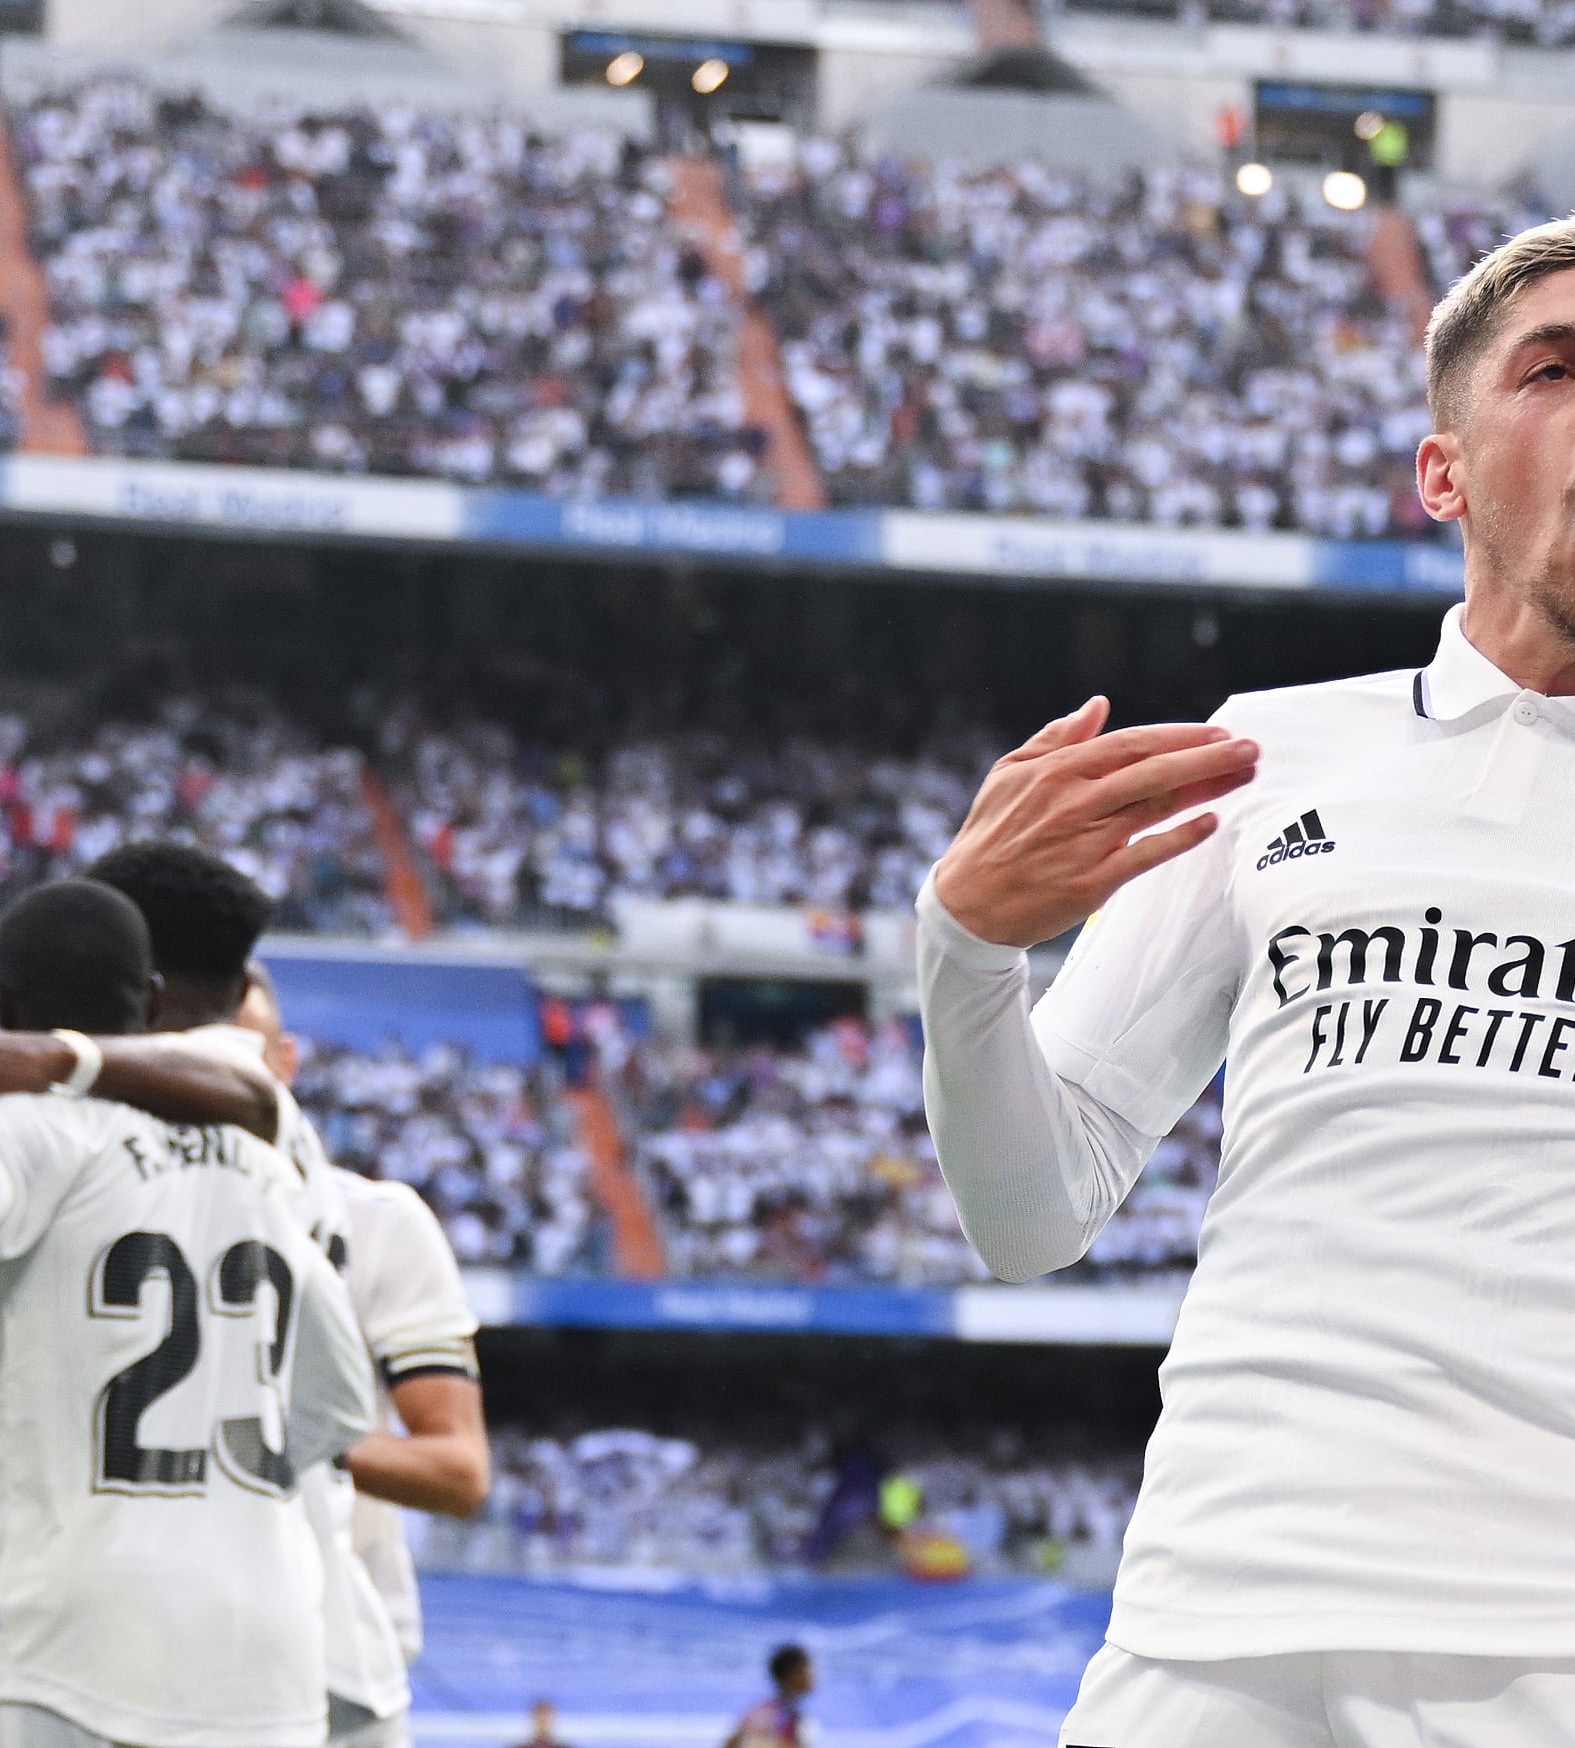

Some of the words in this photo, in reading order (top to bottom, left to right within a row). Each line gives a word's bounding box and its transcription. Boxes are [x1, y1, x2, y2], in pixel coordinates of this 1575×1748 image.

[1256, 840, 1336, 872] adidas
[1303, 997, 1389, 1075] FLY
[87, 1230, 295, 1500] 23
